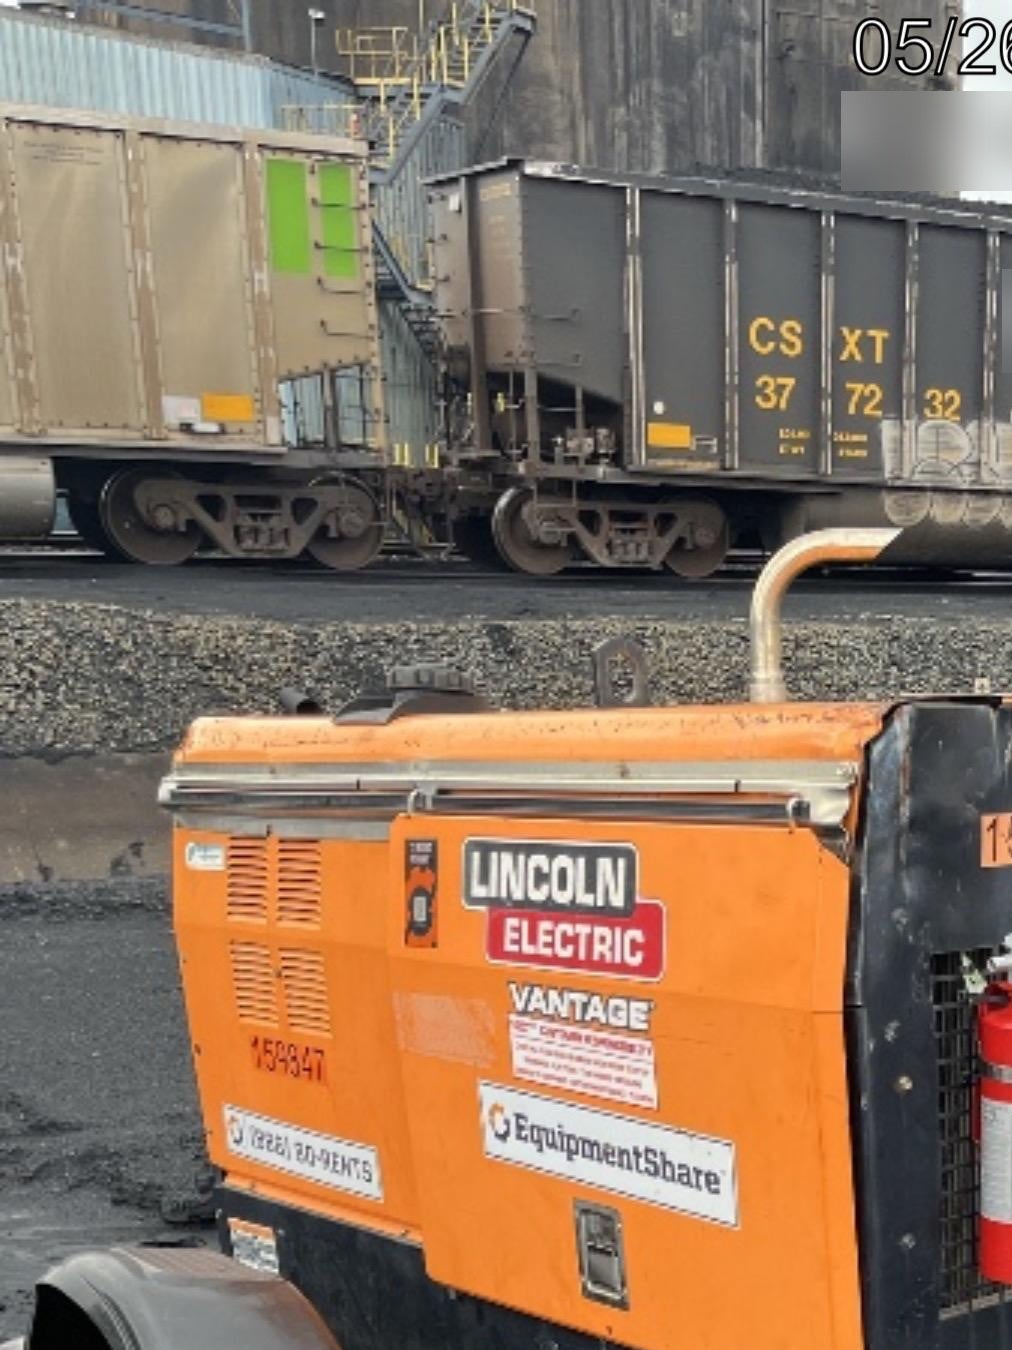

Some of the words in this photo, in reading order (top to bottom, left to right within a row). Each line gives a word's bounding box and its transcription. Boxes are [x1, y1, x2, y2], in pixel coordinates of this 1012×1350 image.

[749, 316, 803, 357] CS
[839, 326, 889, 364] XT
[754, 374, 797, 411] 37
[844, 383, 883, 417] 72
[922, 388, 961, 422] 32
[469, 850, 628, 908] LINCOLN
[502, 916, 646, 967] ELECTRIC
[508, 981, 652, 1032] VANTAGE
[513, 1111, 721, 1196] EquipmentShare
